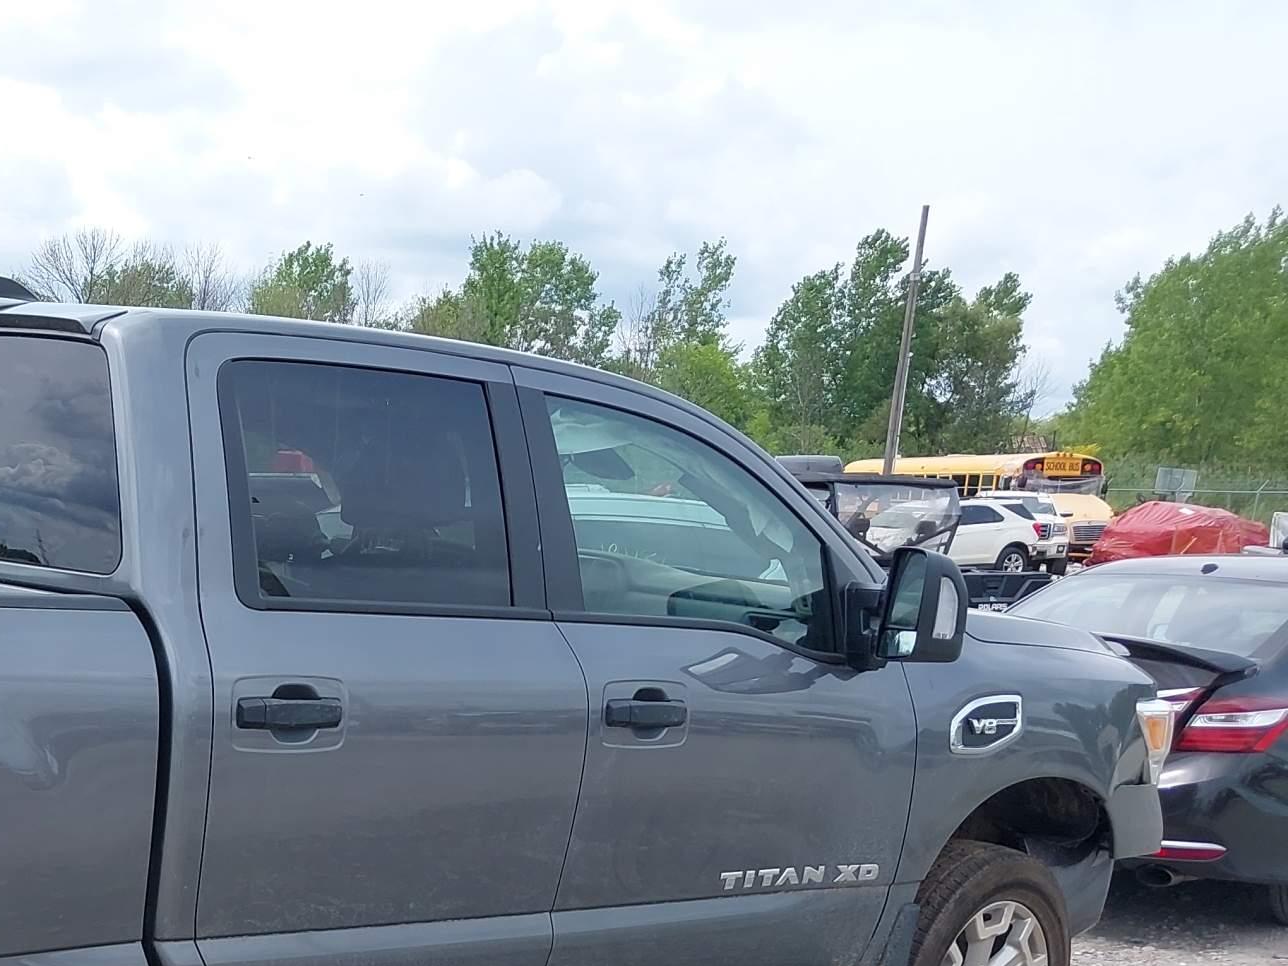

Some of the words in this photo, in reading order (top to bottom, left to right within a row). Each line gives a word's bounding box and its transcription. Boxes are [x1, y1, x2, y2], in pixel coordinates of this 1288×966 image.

[1045, 461, 1067, 472] SCHOOL
[1068, 461, 1080, 472] BUS
[968, 718, 997, 734] V8
[720, 865, 825, 890] TITAN
[833, 863, 880, 882] XD
